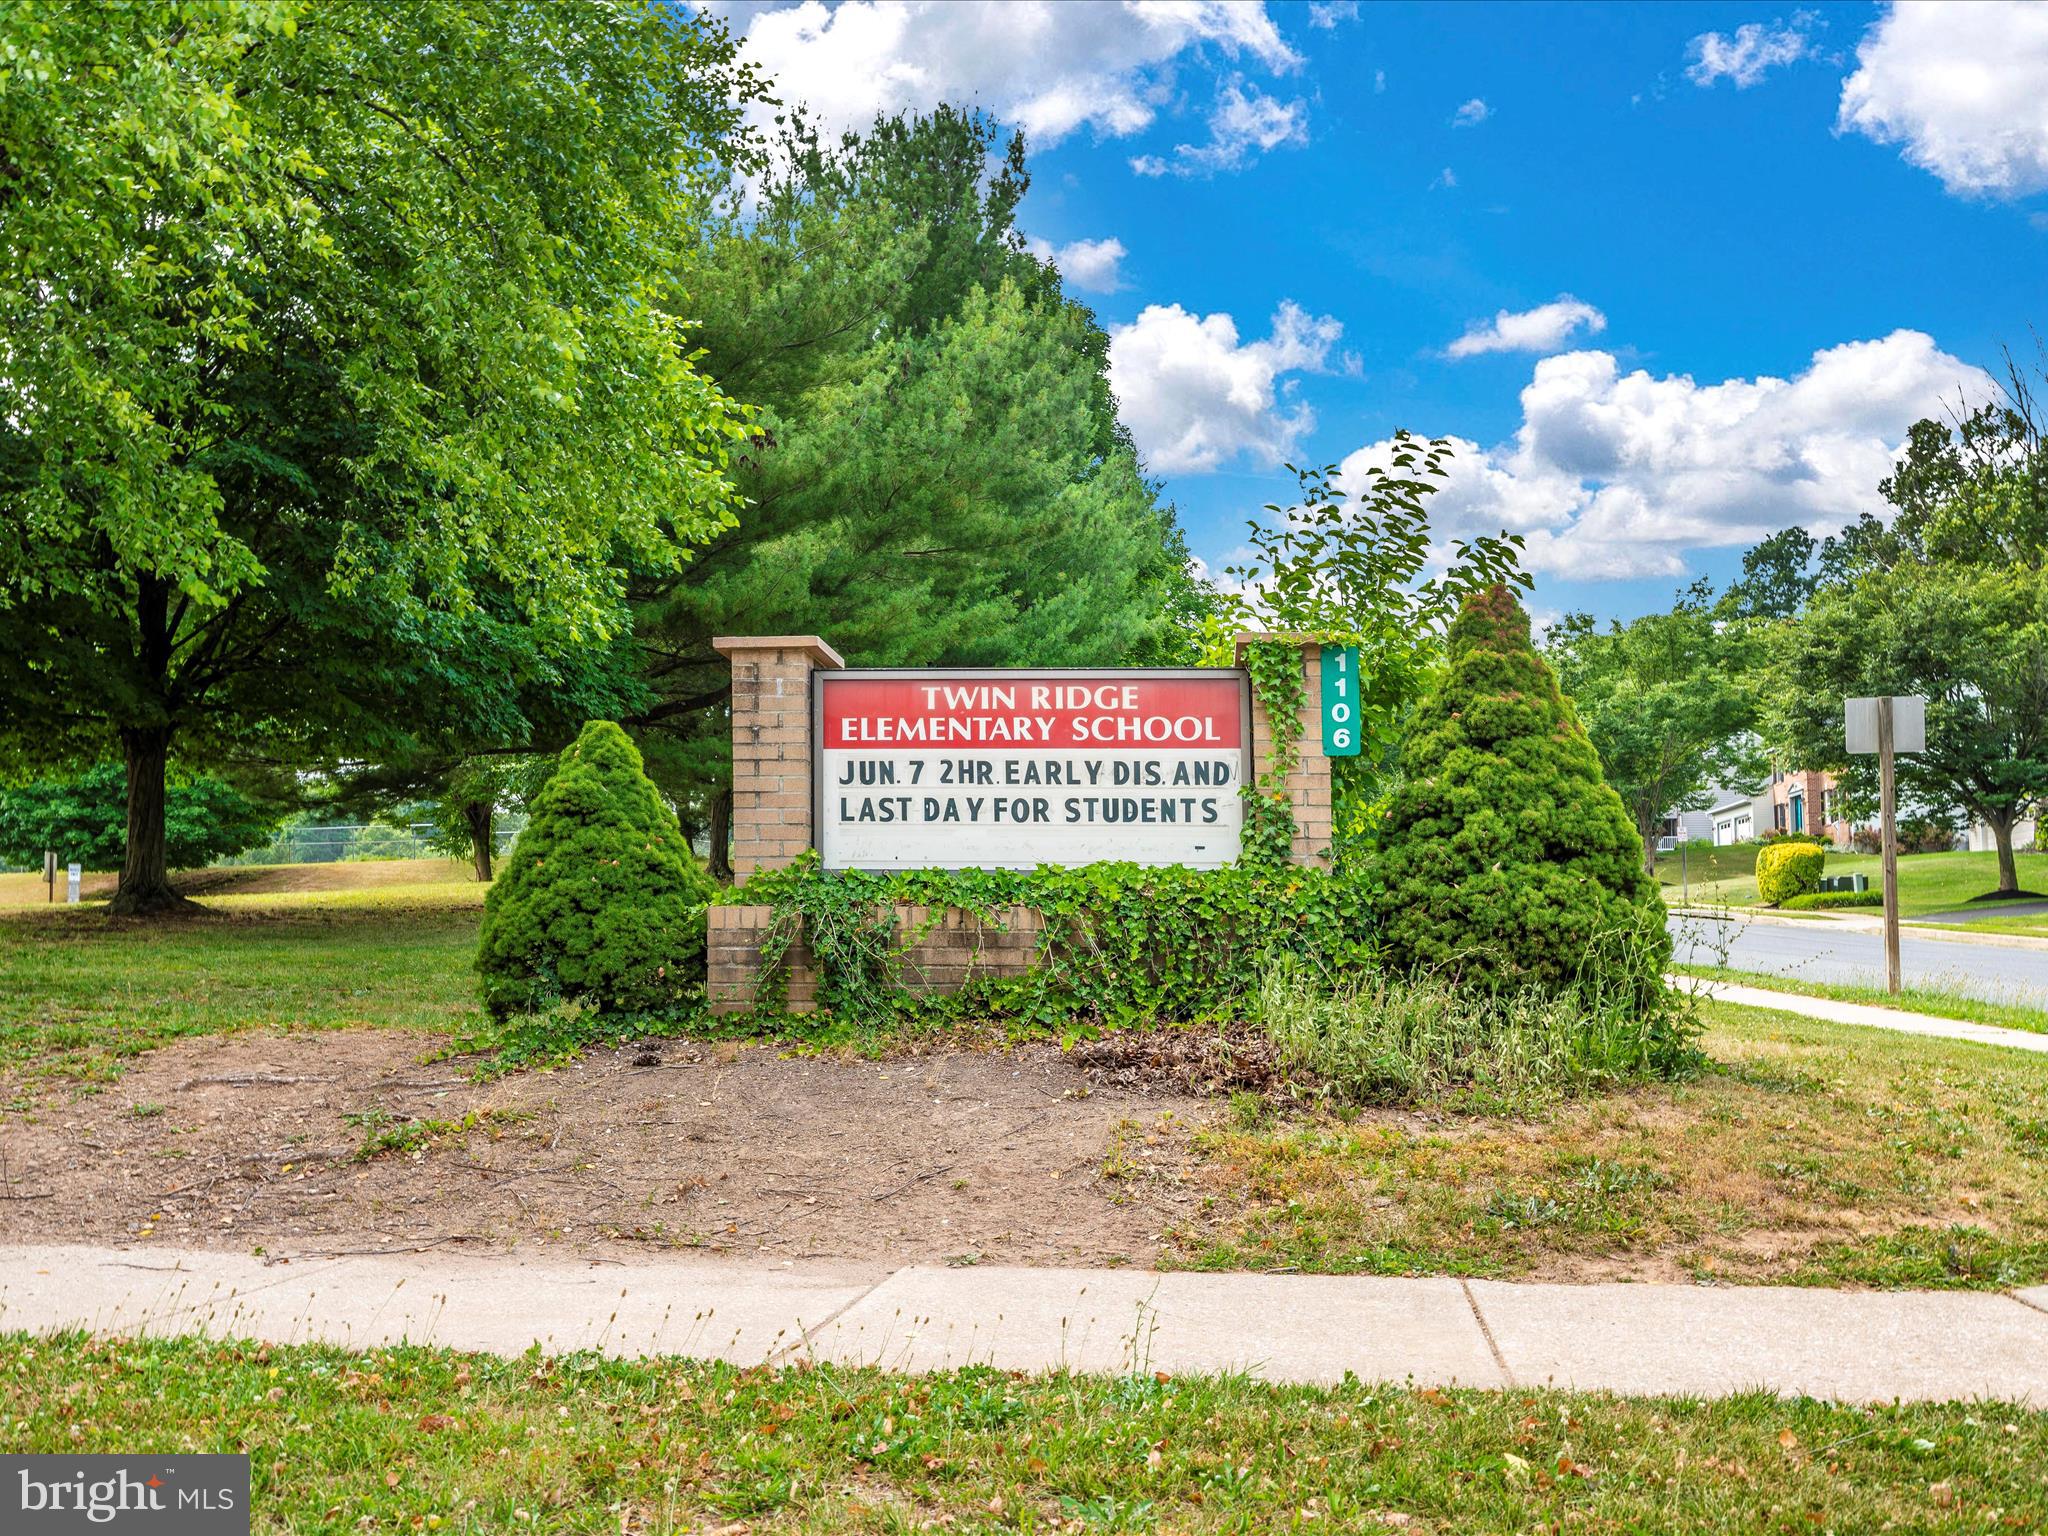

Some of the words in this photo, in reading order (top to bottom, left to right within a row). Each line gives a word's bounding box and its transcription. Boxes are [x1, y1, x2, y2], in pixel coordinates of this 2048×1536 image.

[921, 685, 1016, 710] TWIN
[1031, 685, 1139, 710] RIDGE
[1331, 653, 1350, 748] 1106
[841, 717, 1056, 741] ELEMENTARY
[1072, 716, 1220, 741] SCHOOL
[839, 760, 900, 785] JUN.
[910, 760, 925, 785] 7
[940, 760, 999, 785] 2HR.
[1005, 760, 1102, 785] EARLY
[1114, 760, 1166, 786] DIS.
[1173, 760, 1230, 786] AND
[840, 797, 912, 822] LAST
[924, 797, 985, 822] DAY
[994, 797, 1050, 823] FOR
[1065, 797, 1218, 823] STUDENTS
